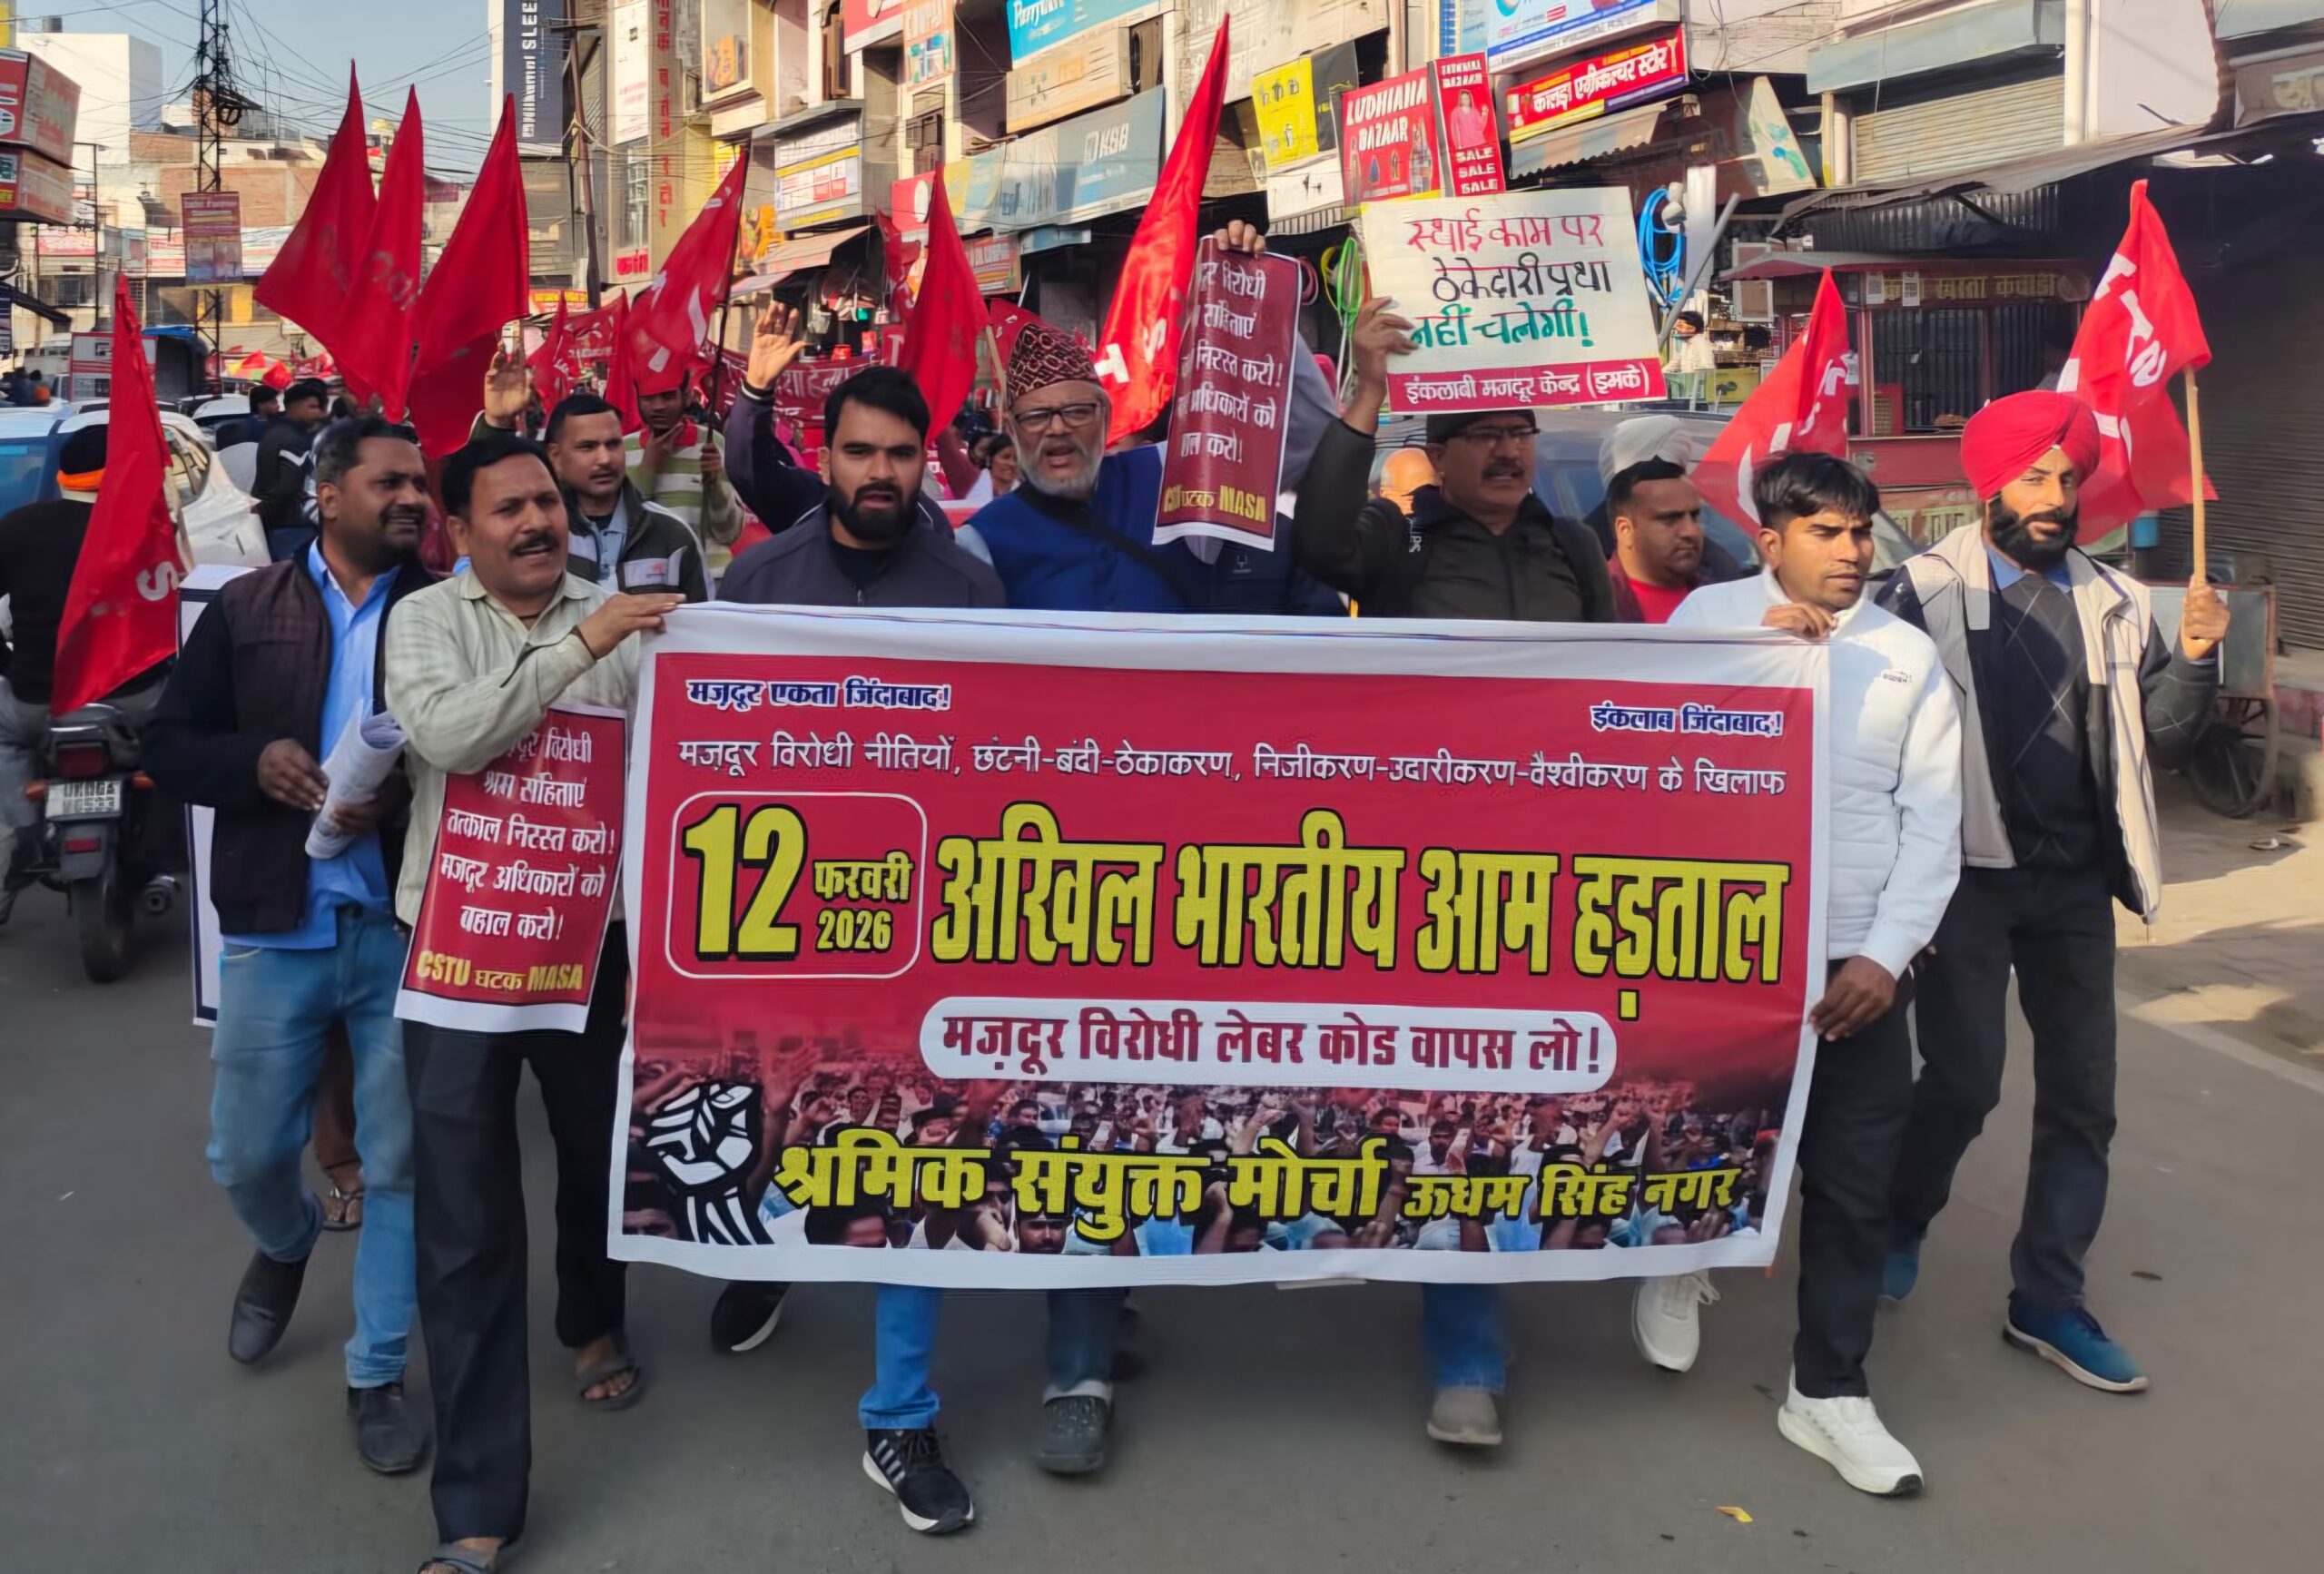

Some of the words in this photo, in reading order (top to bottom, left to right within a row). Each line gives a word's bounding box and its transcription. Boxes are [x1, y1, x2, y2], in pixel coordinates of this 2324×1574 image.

[1346, 77, 1427, 126] LUDHIANA
[1359, 116, 1408, 152] BAZAAR
[1456, 146, 1494, 163] SALE
[1459, 163, 1496, 178] SALE
[1461, 179, 1498, 194] SALE
[1489, 217, 1551, 247] काम
[1557, 214, 1604, 247] पर
[1411, 303, 1472, 348] नहीं
[1472, 298, 1595, 348] चलेगी!
[1404, 373, 1475, 404] इंकलाबी
[1586, 360, 1649, 398] (इमके)
[1254, 397, 1276, 429] को
[1219, 485, 1267, 522] MASA
[687, 681, 761, 709] मज़दूर
[772, 683, 836, 706] एकता
[845, 678, 950, 709] जिंदाबाद!
[1591, 702, 1674, 731] इंकलाब
[1683, 703, 1782, 736] जिंदाबाद!
[547, 727, 592, 762] विरोधी
[679, 741, 757, 775] मज़दूर
[773, 732, 853, 770] विरोधी
[864, 735, 960, 776] नीतियों,
[1659, 757, 1682, 792] के
[1696, 760, 1785, 795] खिलाफ
[447, 808, 502, 843] तत्काल
[507, 813, 566, 851] निरस्त
[572, 821, 615, 855] करो!
[493, 860, 579, 896] अधिकारों
[580, 865, 606, 898] को
[684, 803, 807, 961] 12
[814, 851, 911, 902] फरवरी
[517, 906, 564, 941] करो!
[931, 802, 1164, 966] अखिल
[1175, 808, 1406, 970] भारतीय
[1415, 847, 1560, 974] आम
[1574, 854, 1790, 1020] हड़ताल
[817, 909, 892, 952] 2026
[417, 949, 471, 987] CSTU
[474, 969, 526, 991] घटक
[527, 964, 584, 991] MASA
[943, 1016, 1068, 1075] मज़दूर
[1079, 1008, 1202, 1062] विरोधी
[1216, 1009, 1305, 1064] लेबर
[1319, 1011, 1399, 1067] कोड
[1410, 1026, 1516, 1070] वापस
[774, 1128, 990, 1208] श्रमिक
[1011, 1135, 1210, 1242] संयुक्त
[1228, 1136, 1388, 1217] मोर्चा
[1404, 1174, 1531, 1220] ऊधम
[1541, 1162, 1635, 1216] सिंह
[1645, 1167, 1741, 1211] नगर
